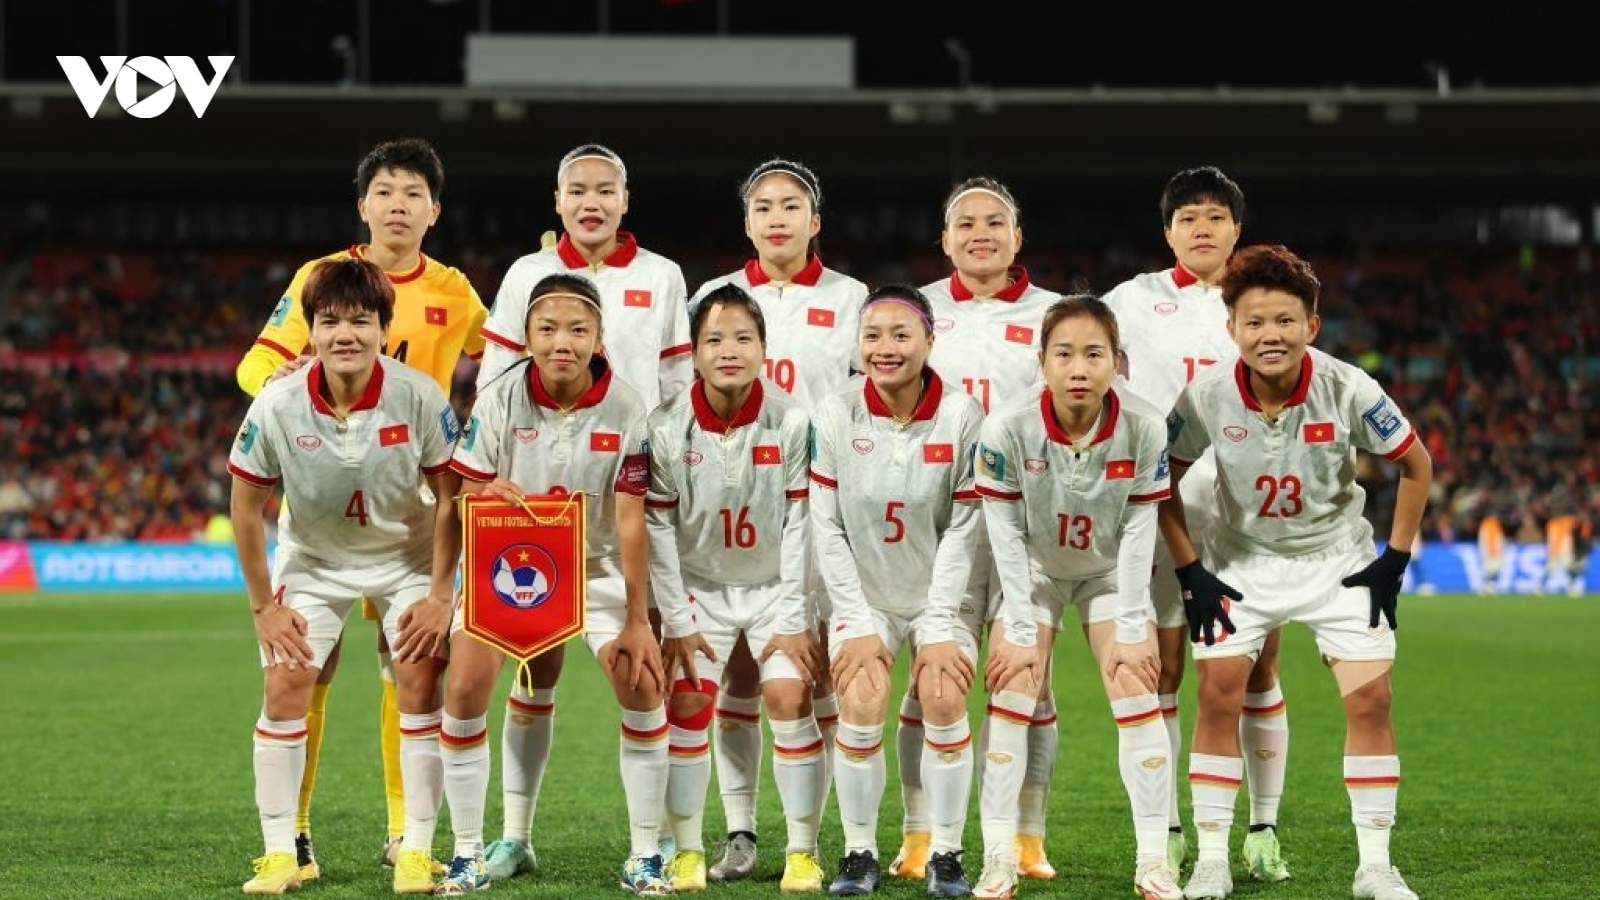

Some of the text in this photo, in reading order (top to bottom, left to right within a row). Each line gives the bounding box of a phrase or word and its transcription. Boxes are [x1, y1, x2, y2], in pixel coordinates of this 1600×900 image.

[344, 490, 369, 527] 4
[1255, 475, 1303, 518] 23
[476, 516, 503, 528] VIETNAM
[504, 516, 534, 528] FOOTBALL
[719, 506, 756, 548] 16
[883, 501, 905, 544] 5
[1057, 513, 1092, 550] 13
[515, 591, 534, 600] VFF
